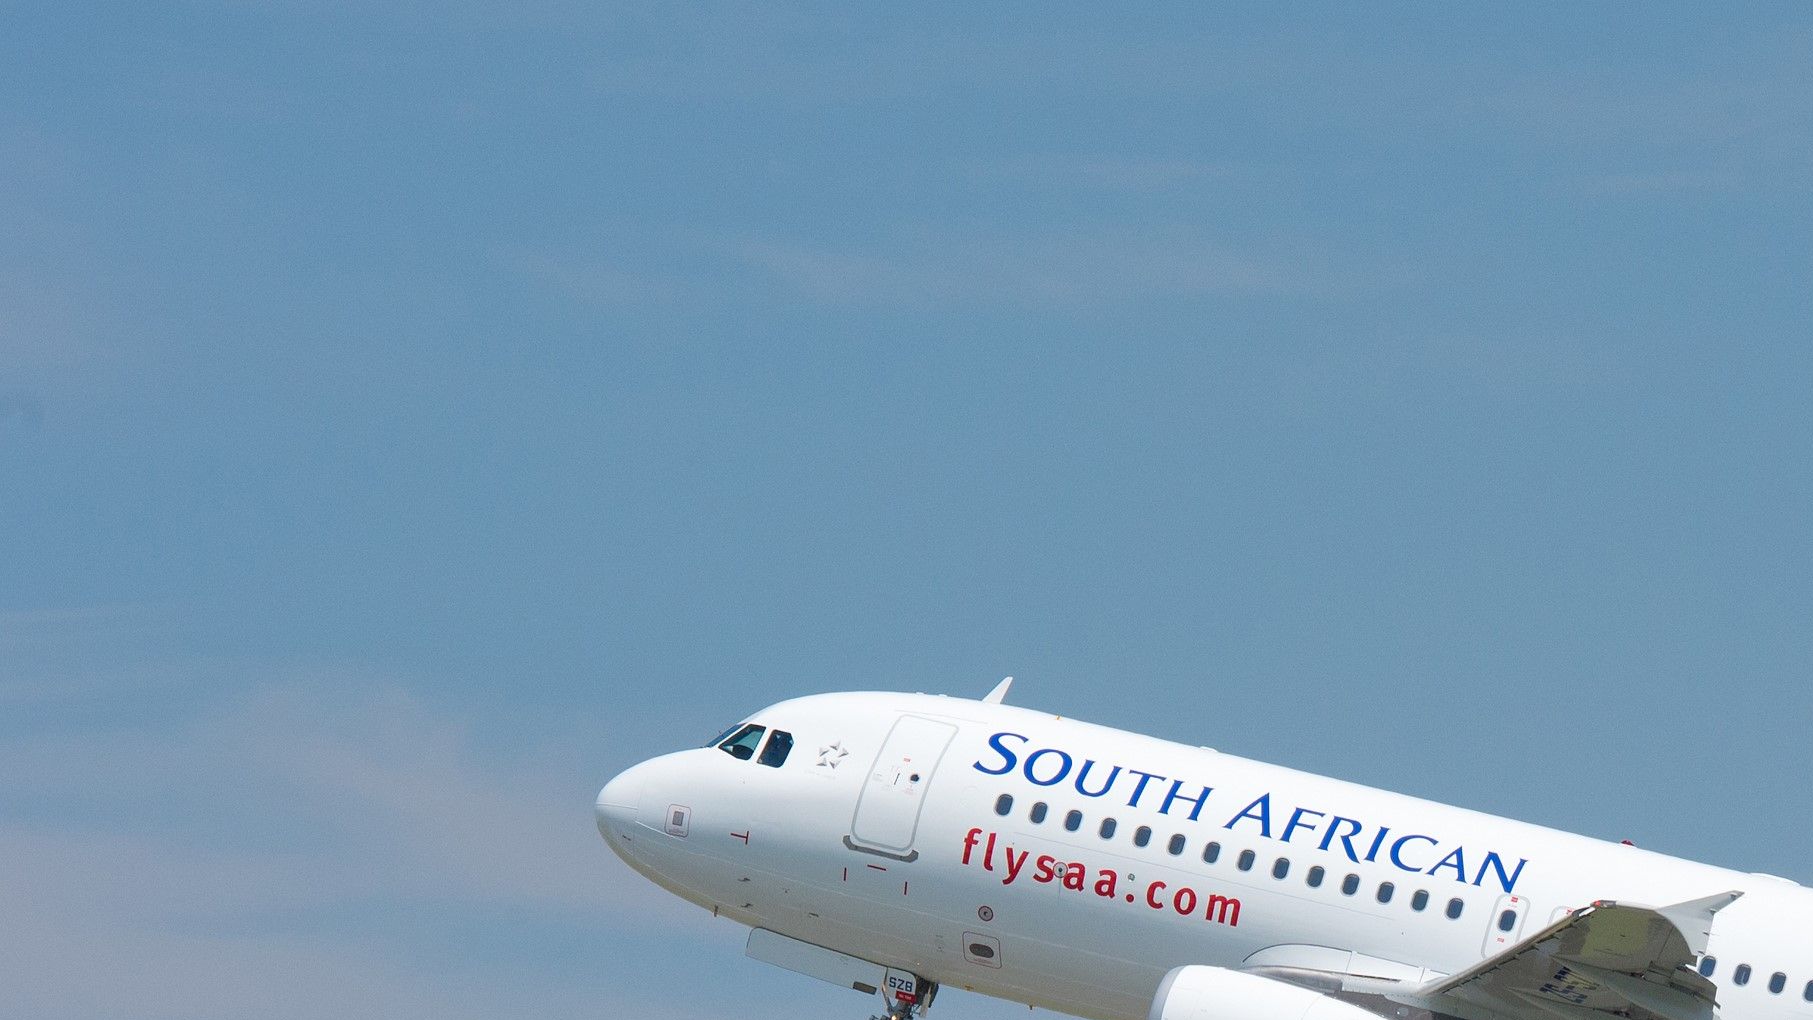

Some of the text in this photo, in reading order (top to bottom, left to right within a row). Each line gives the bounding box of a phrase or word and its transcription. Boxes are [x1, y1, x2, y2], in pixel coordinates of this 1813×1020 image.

[973, 732, 1528, 894] SOUTH AFRICAN
[961, 828, 1242, 927] flysaa.com
[889, 976, 913, 992] SZB
